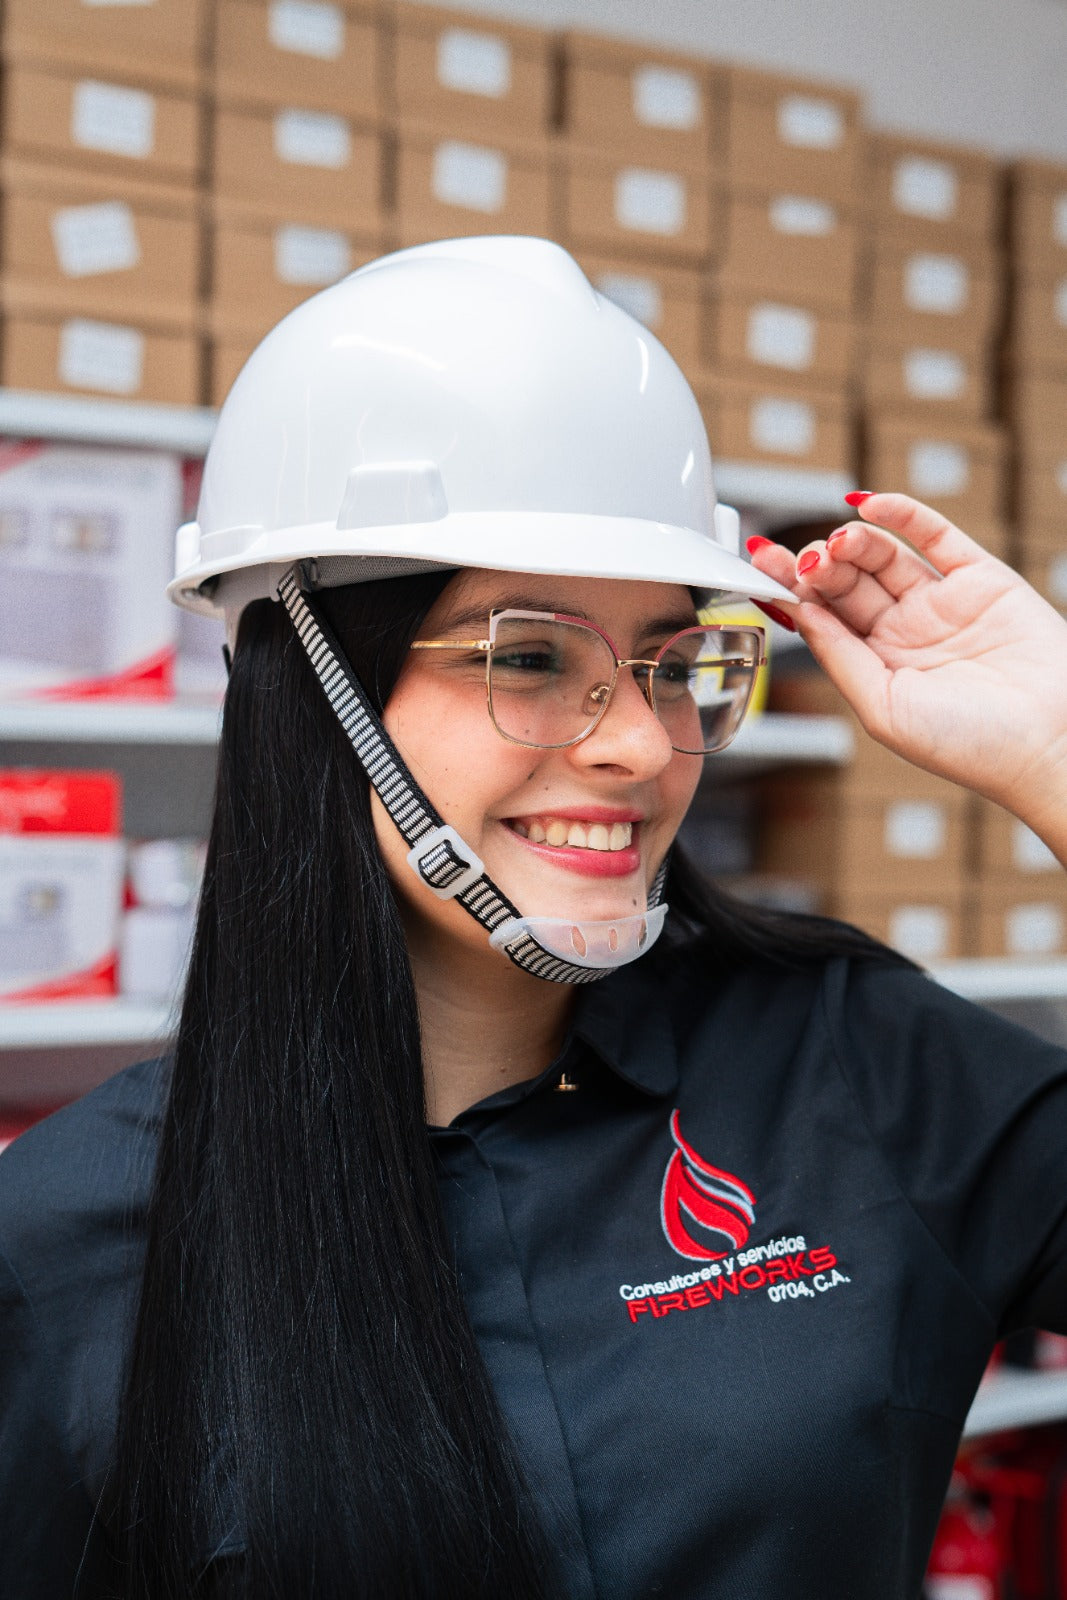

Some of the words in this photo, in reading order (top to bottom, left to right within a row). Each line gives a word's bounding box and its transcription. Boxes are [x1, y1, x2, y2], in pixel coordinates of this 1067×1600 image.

[619, 1263, 722, 1301] Consultores
[722, 1258, 735, 1275] y
[737, 1235, 807, 1267] servicios
[626, 1245, 838, 1323] FIREWORKS
[768, 1281, 815, 1303] 0704,
[813, 1269, 851, 1292] C.A.
